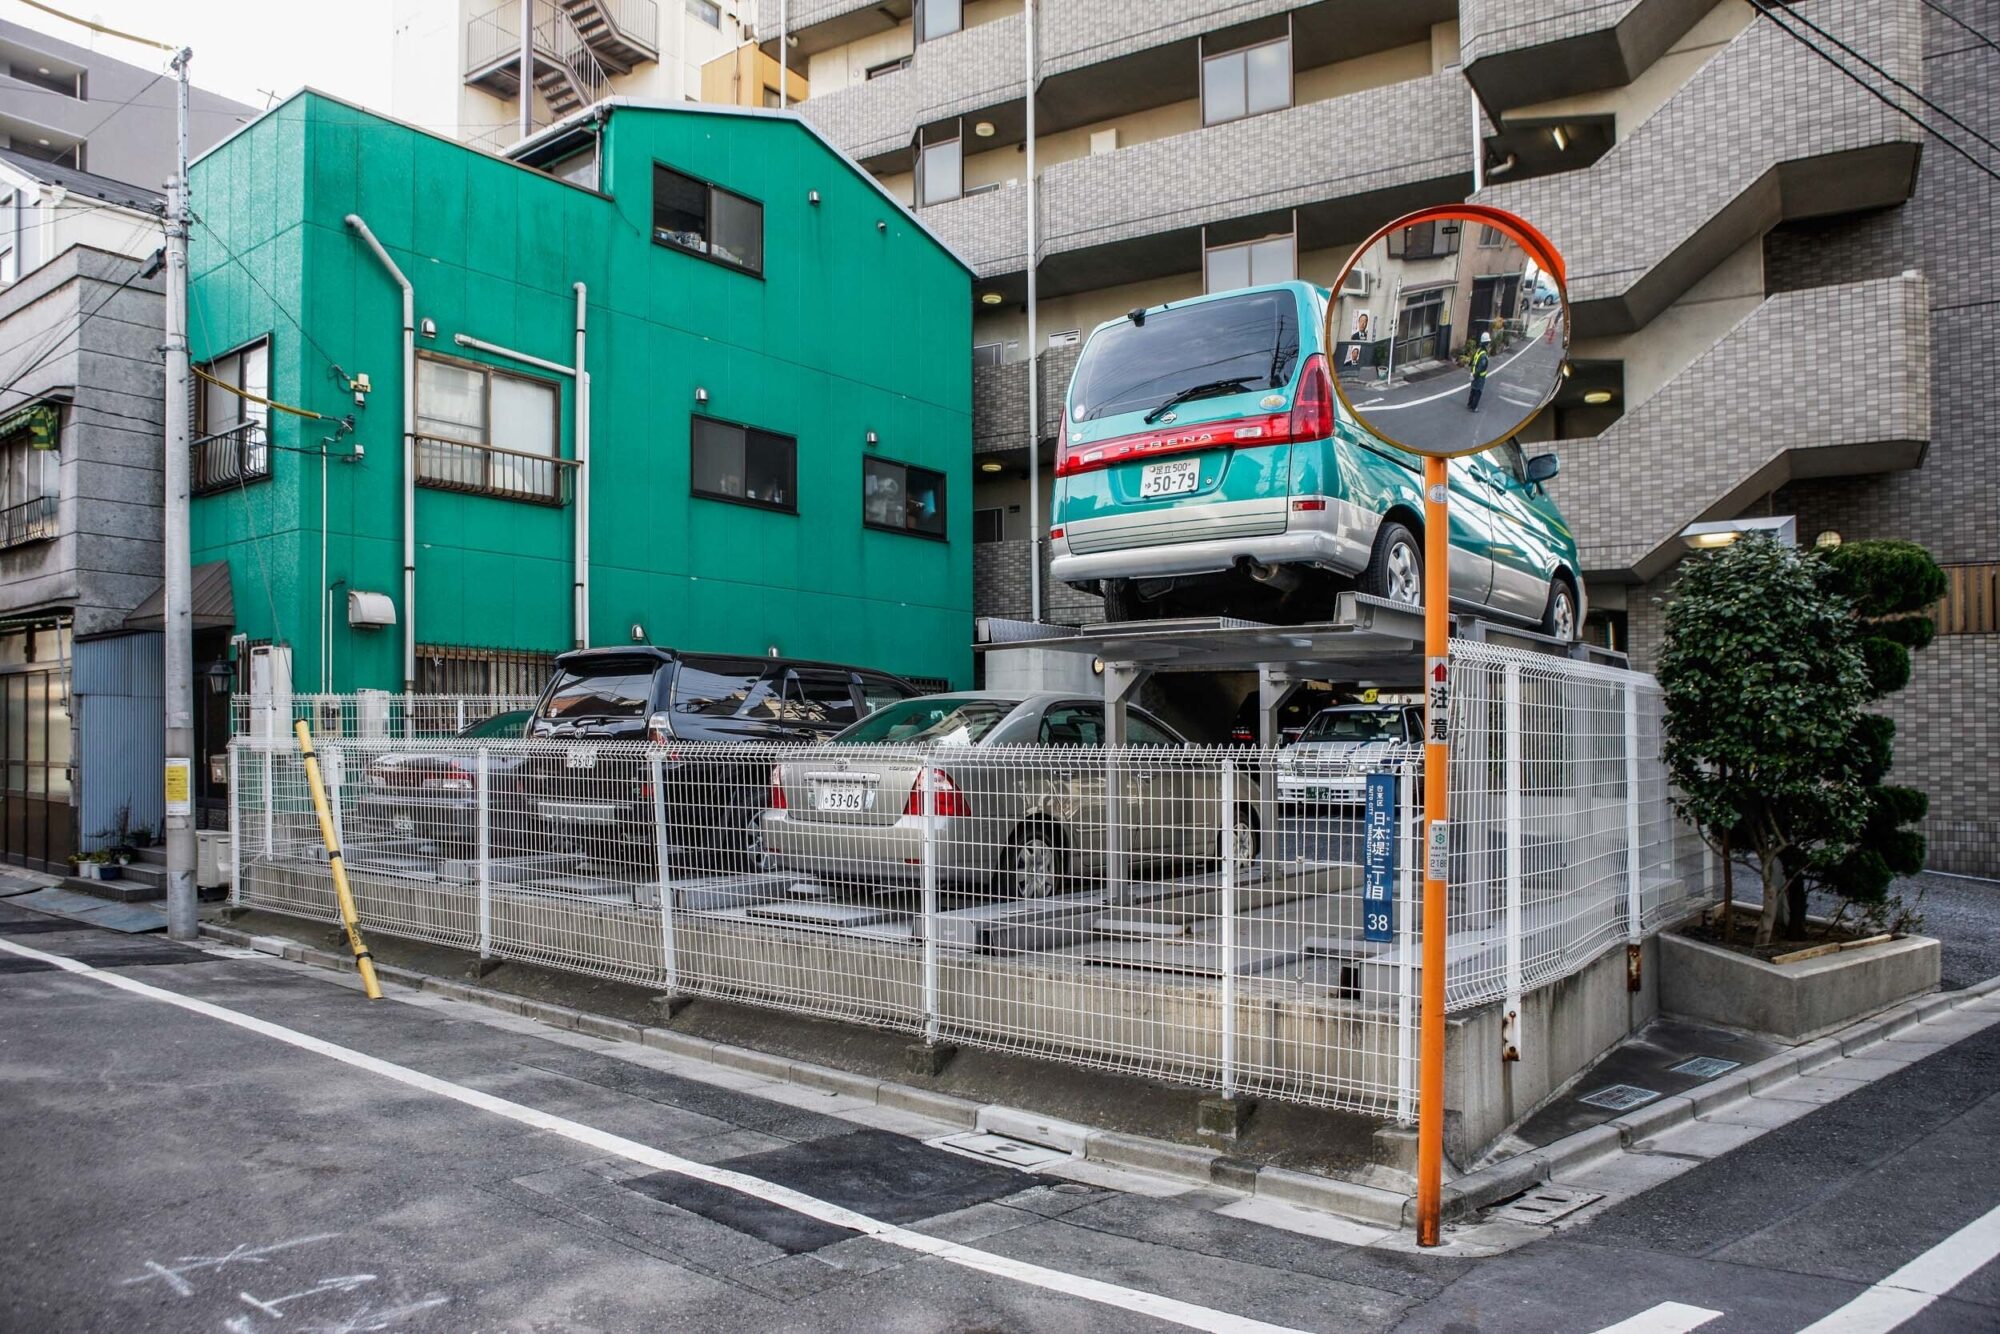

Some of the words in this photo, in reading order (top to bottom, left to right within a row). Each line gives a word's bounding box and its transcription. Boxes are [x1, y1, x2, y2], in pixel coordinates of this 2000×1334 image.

[1119, 433, 1214, 454] SERENA
[1153, 472, 1196, 493] 50-79
[1430, 686, 1448, 740] 注意
[830, 793, 860, 809] 53-06
[1371, 811, 1386, 900] 日本堤二丁目
[1367, 913, 1388, 931] 38
